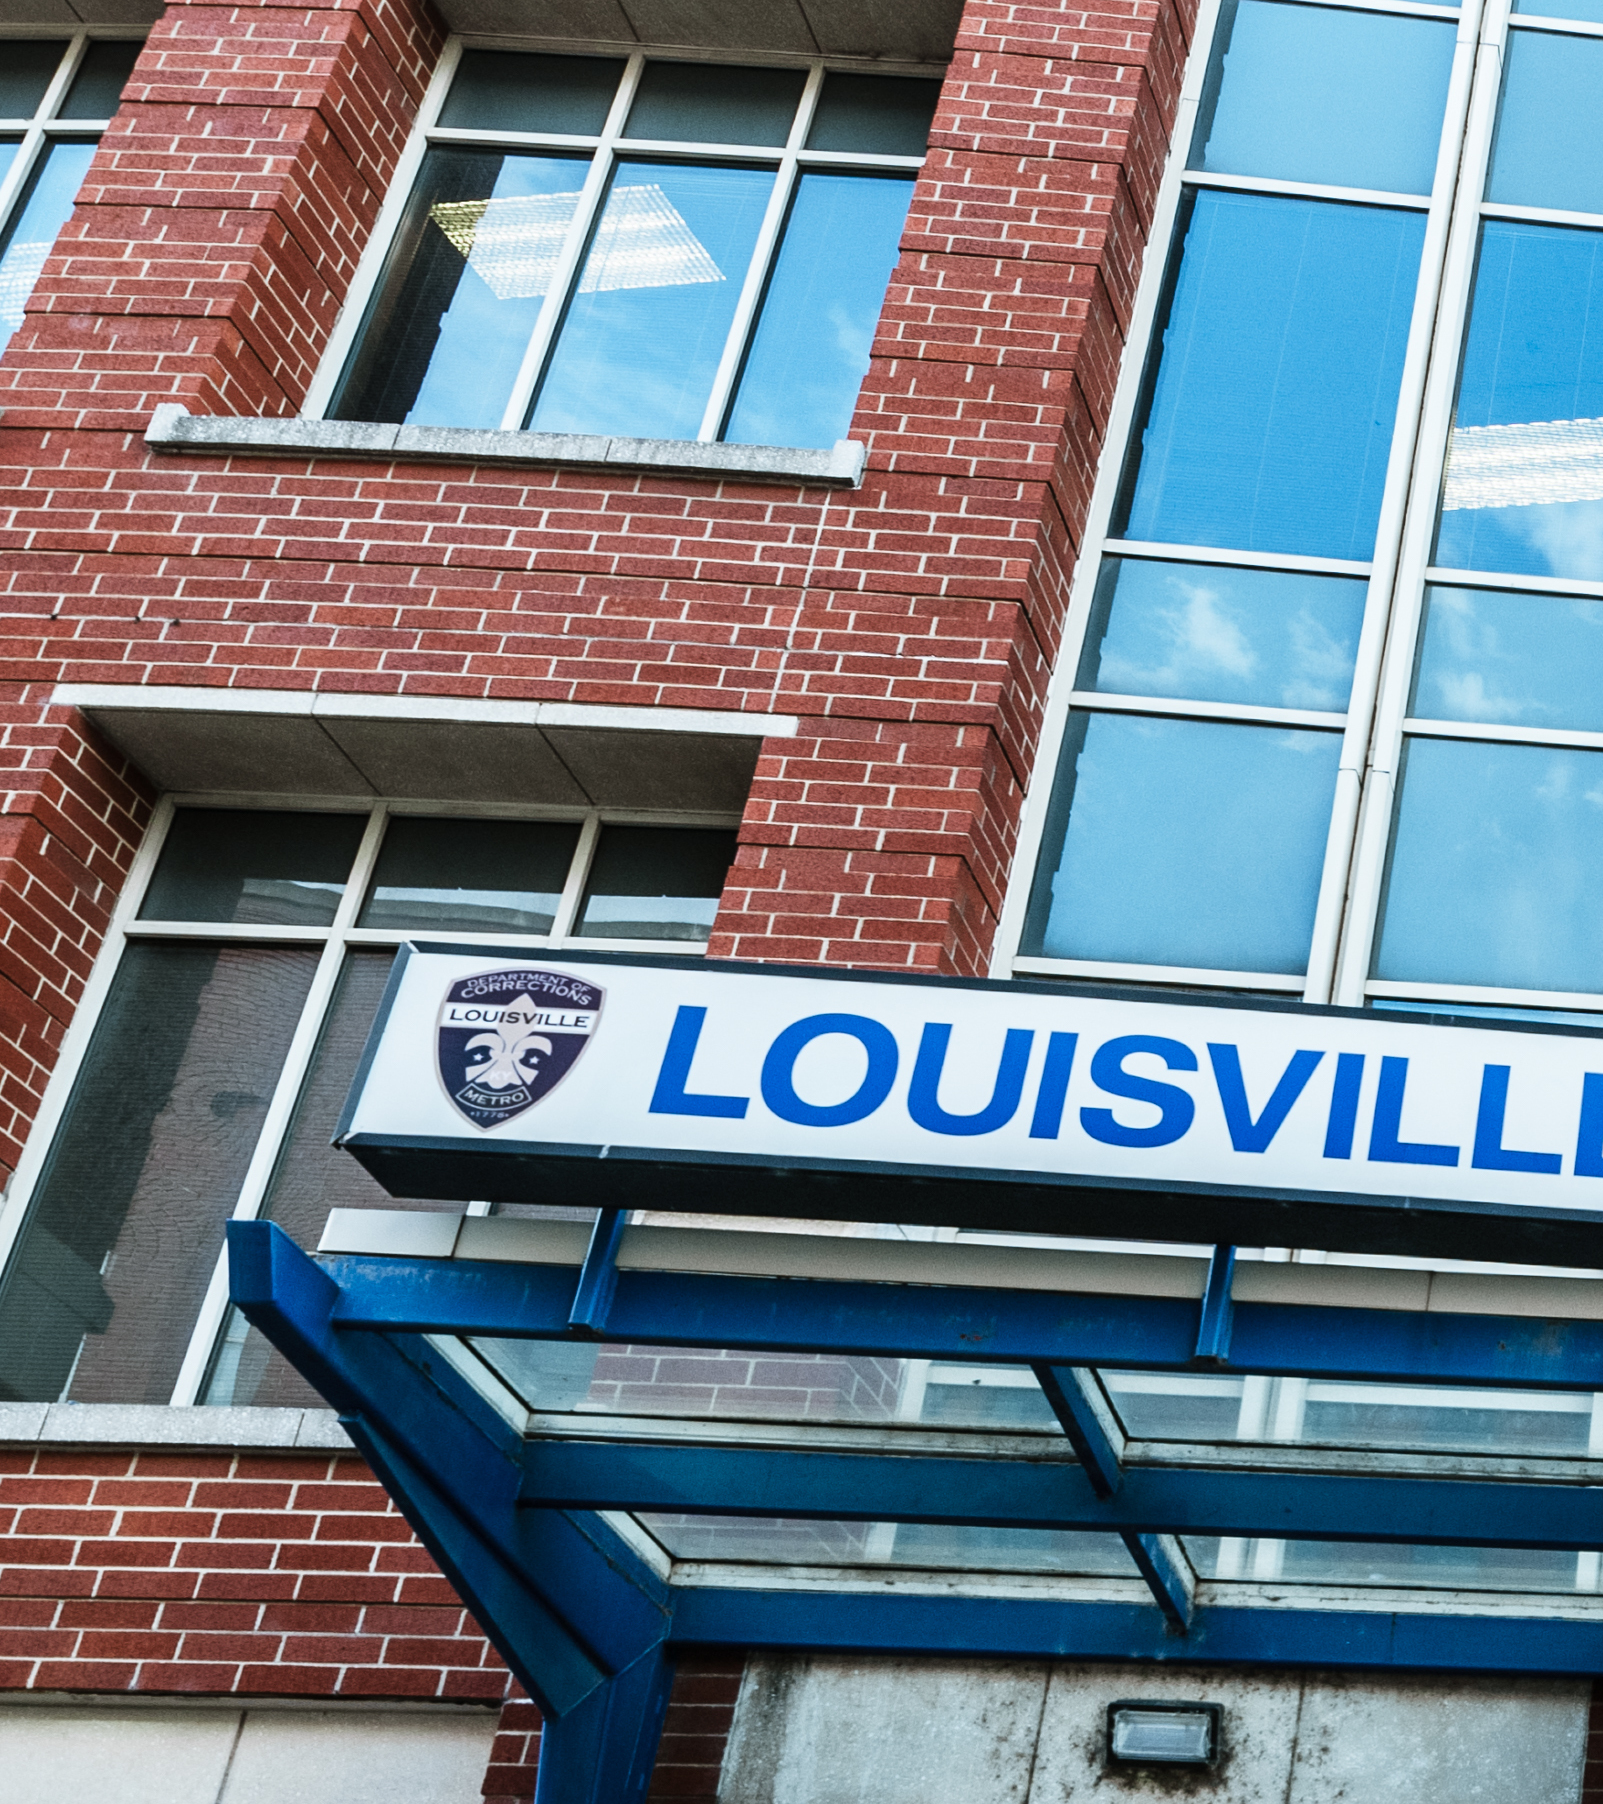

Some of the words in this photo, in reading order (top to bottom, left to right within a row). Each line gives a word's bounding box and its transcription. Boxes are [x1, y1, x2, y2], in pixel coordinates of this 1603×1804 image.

[467, 972, 569, 988] DEPARTMENT
[571, 982, 592, 993] OF
[460, 980, 593, 1006] CORRECTIONS
[449, 1008, 590, 1028] LOUISVILLE
[464, 1089, 524, 1105] METRO
